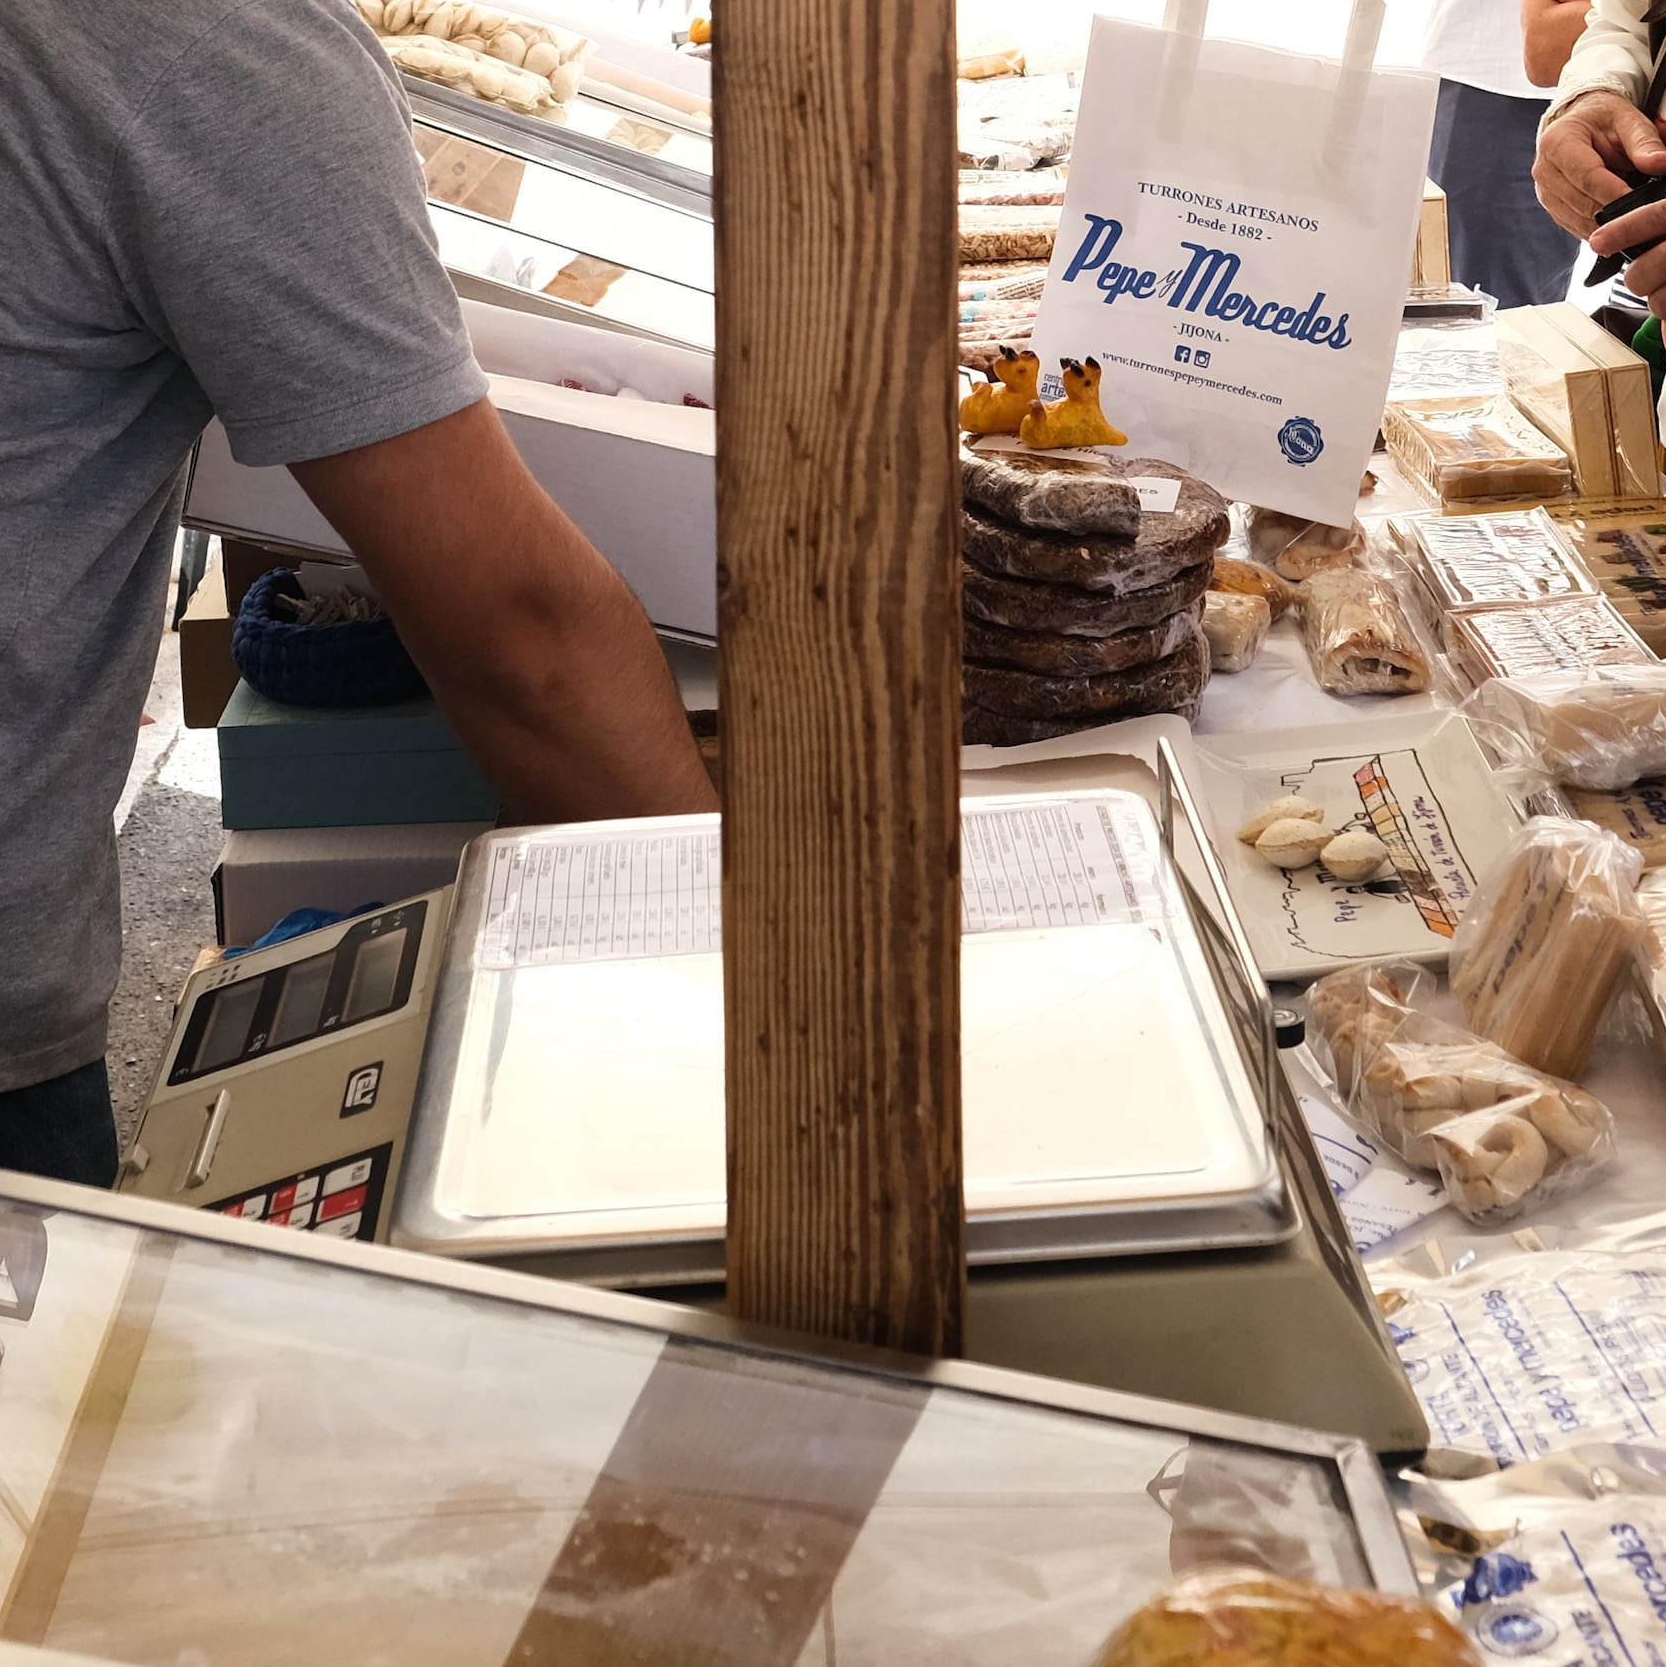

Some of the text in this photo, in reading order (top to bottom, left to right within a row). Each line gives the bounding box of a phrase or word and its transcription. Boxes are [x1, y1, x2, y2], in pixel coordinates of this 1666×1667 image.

[1138, 182, 1319, 232] TURRONES ARTESANOS
[1186, 212, 1263, 241] Desde 1882
[1061, 213, 1352, 349] Pepe y Mercedes
[1180, 323, 1222, 343] JIJONA
[1041, 383, 1066, 397] arte
[1044, 373, 1062, 383] centr
